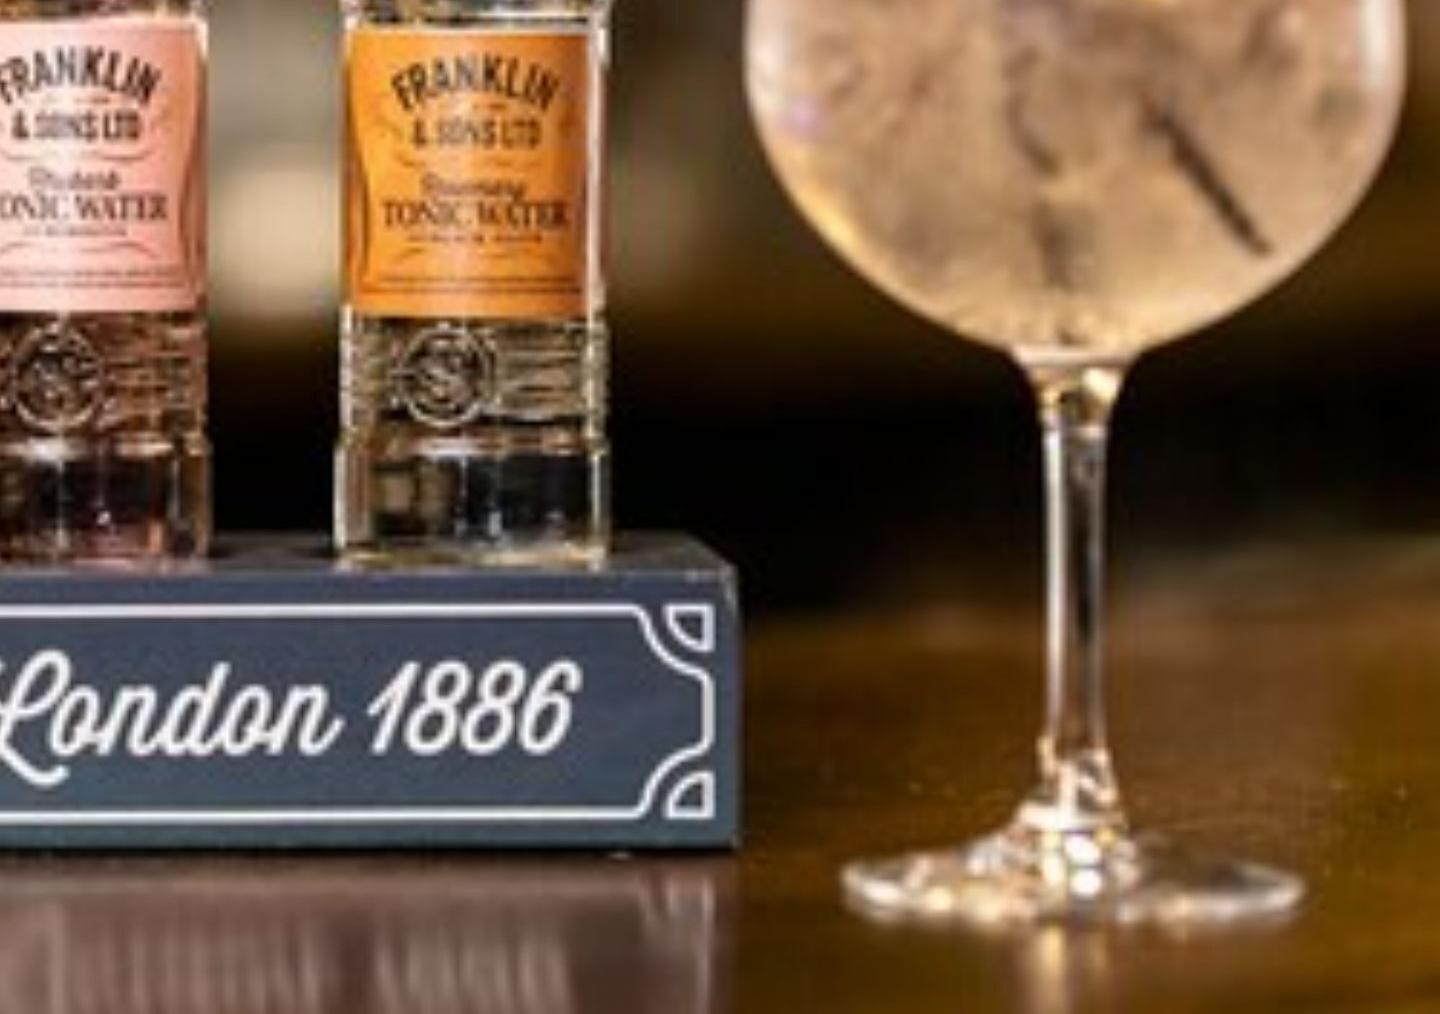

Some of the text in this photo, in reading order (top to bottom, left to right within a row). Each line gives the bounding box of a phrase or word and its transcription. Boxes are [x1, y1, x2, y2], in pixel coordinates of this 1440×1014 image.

[391, 52, 559, 112] FRANKLIN
[12, 109, 140, 142] & SONS LTD
[411, 118, 542, 148] & SONS LTD
[75, 190, 167, 220] WATER
[383, 199, 569, 229] TONIC WATER
[366, 660, 584, 757] 1886
